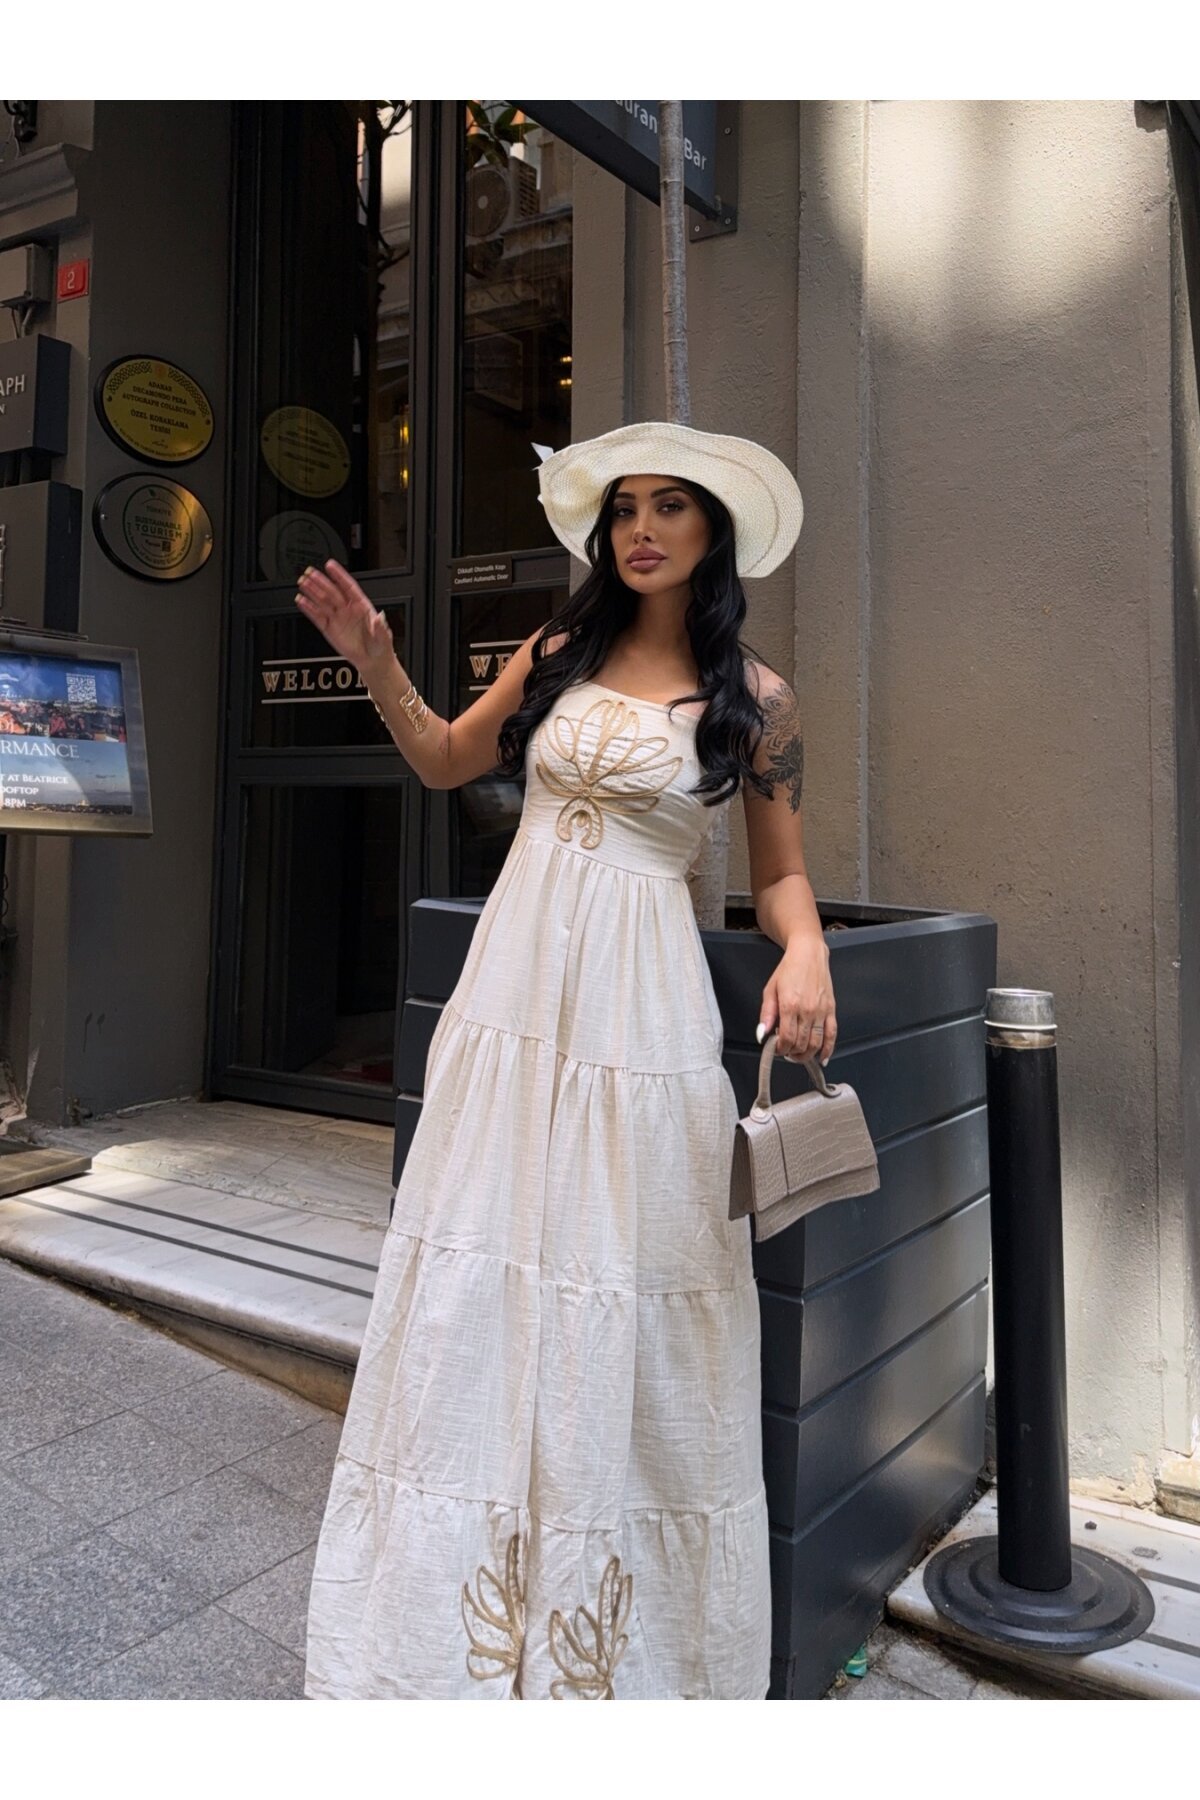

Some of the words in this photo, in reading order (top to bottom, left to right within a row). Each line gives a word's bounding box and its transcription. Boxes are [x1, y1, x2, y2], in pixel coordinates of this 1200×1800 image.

[683, 137, 707, 170] Bar
[67, 271, 75, 289] 2
[160, 401, 196, 416] COLLECTION
[135, 515, 182, 531] SUSTAINABLE
[135, 523, 182, 539] TOURISM
[7, 774, 20, 782] AT
